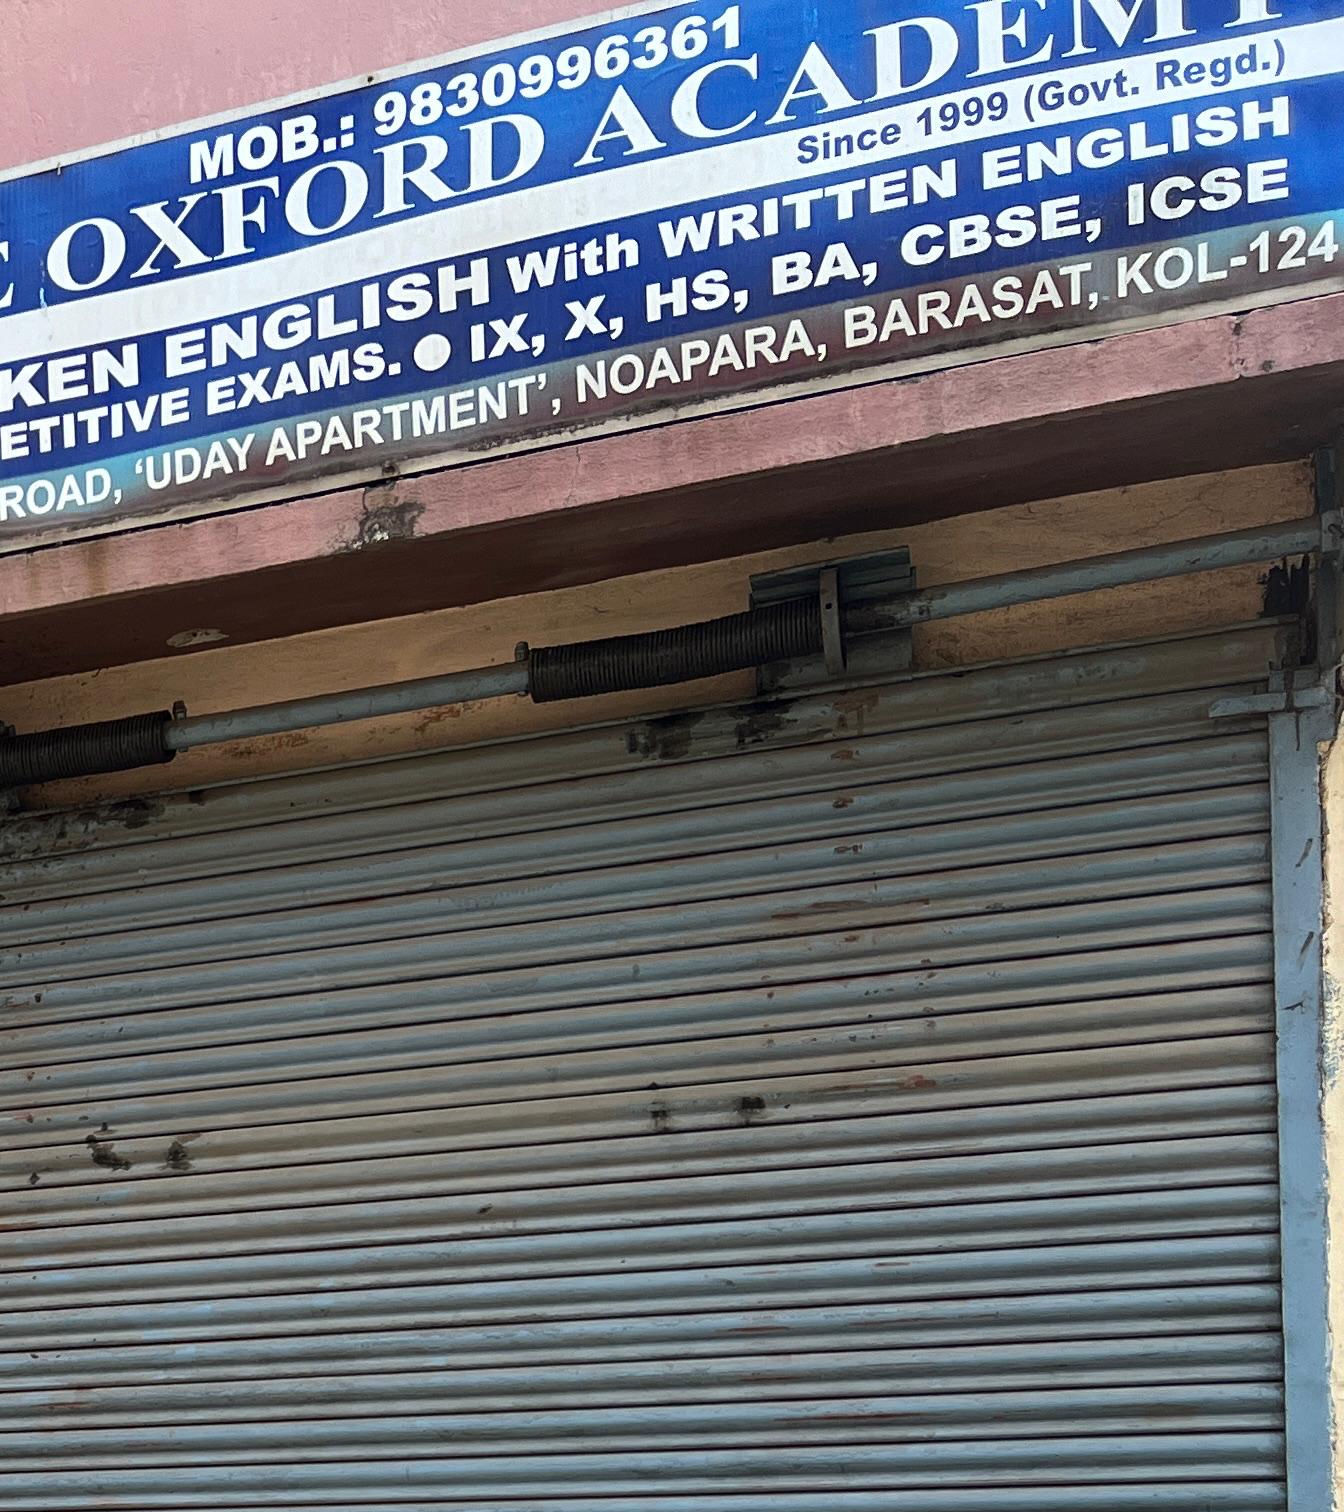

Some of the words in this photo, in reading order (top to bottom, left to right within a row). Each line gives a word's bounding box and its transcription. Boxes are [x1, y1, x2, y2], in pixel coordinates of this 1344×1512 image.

[46, 113, 545, 291] OXFORD
[574, 0, 1282, 167] ACADEM
[373, 5, 741, 135] 9830996361
[796, 122, 901, 164] Since
[917, 91, 1009, 137] 1999
[1024, 69, 1140, 122] (Govt.
[1156, 39, 1286, 91] Regd.)
[165, 254, 491, 375] ENGLISH
[507, 233, 639, 293] With
[658, 161, 957, 257] WRITTEN
[982, 96, 1290, 189] ENGLISH
[206, 343, 401, 417] EXAMS.
[470, 312, 545, 362] IX,
[564, 294, 624, 341] X,
[645, 270, 748, 323] HS,
[772, 250, 878, 297] BA,
[901, 195, 1102, 267] CBSE,
[1127, 158, 1290, 227] ICSE
[0, 466, 123, 525] ROAD,
[577, 318, 827, 404] NOAPARA,
[845, 262, 1099, 349] BARASAT,
[1117, 219, 1340, 299] KOL-124
